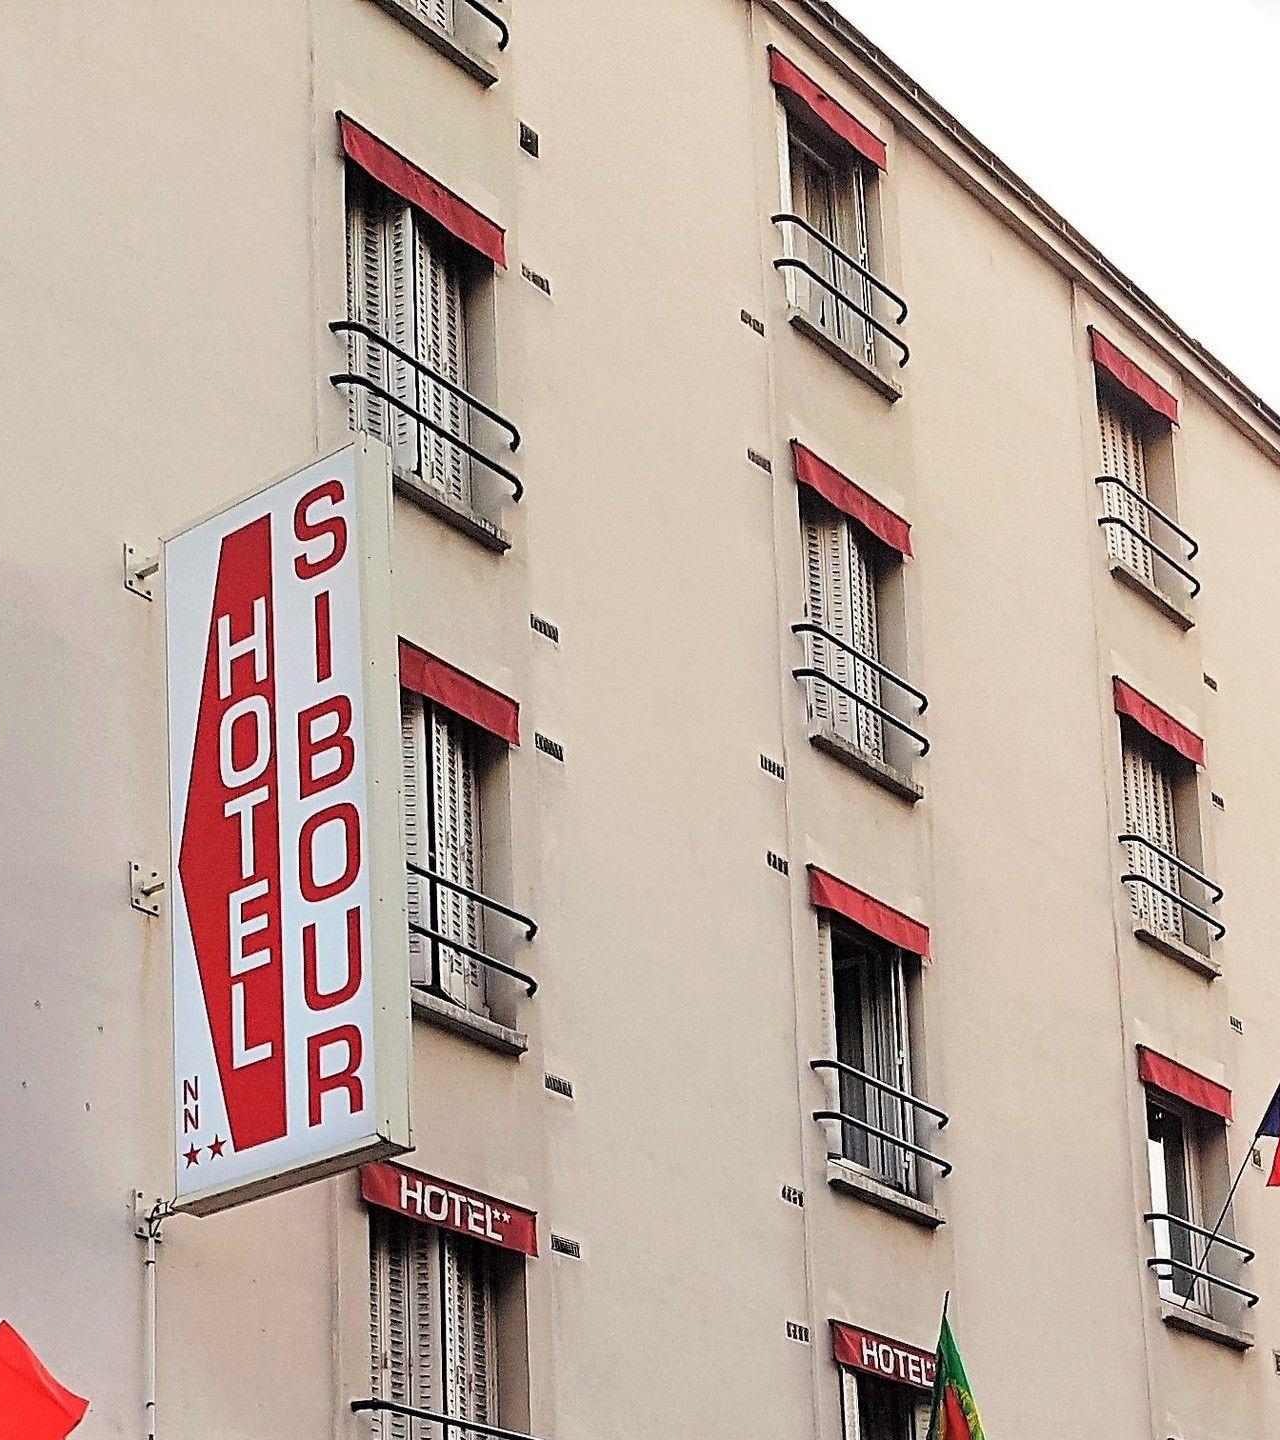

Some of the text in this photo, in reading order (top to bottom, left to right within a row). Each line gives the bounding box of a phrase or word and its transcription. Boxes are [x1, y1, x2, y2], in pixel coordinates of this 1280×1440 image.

[217, 596, 273, 1069] HOTEL
[293, 479, 364, 1127] SIBOUR
[400, 1174, 503, 1242] HOTEL
[861, 1336, 934, 1388] HOTEL
